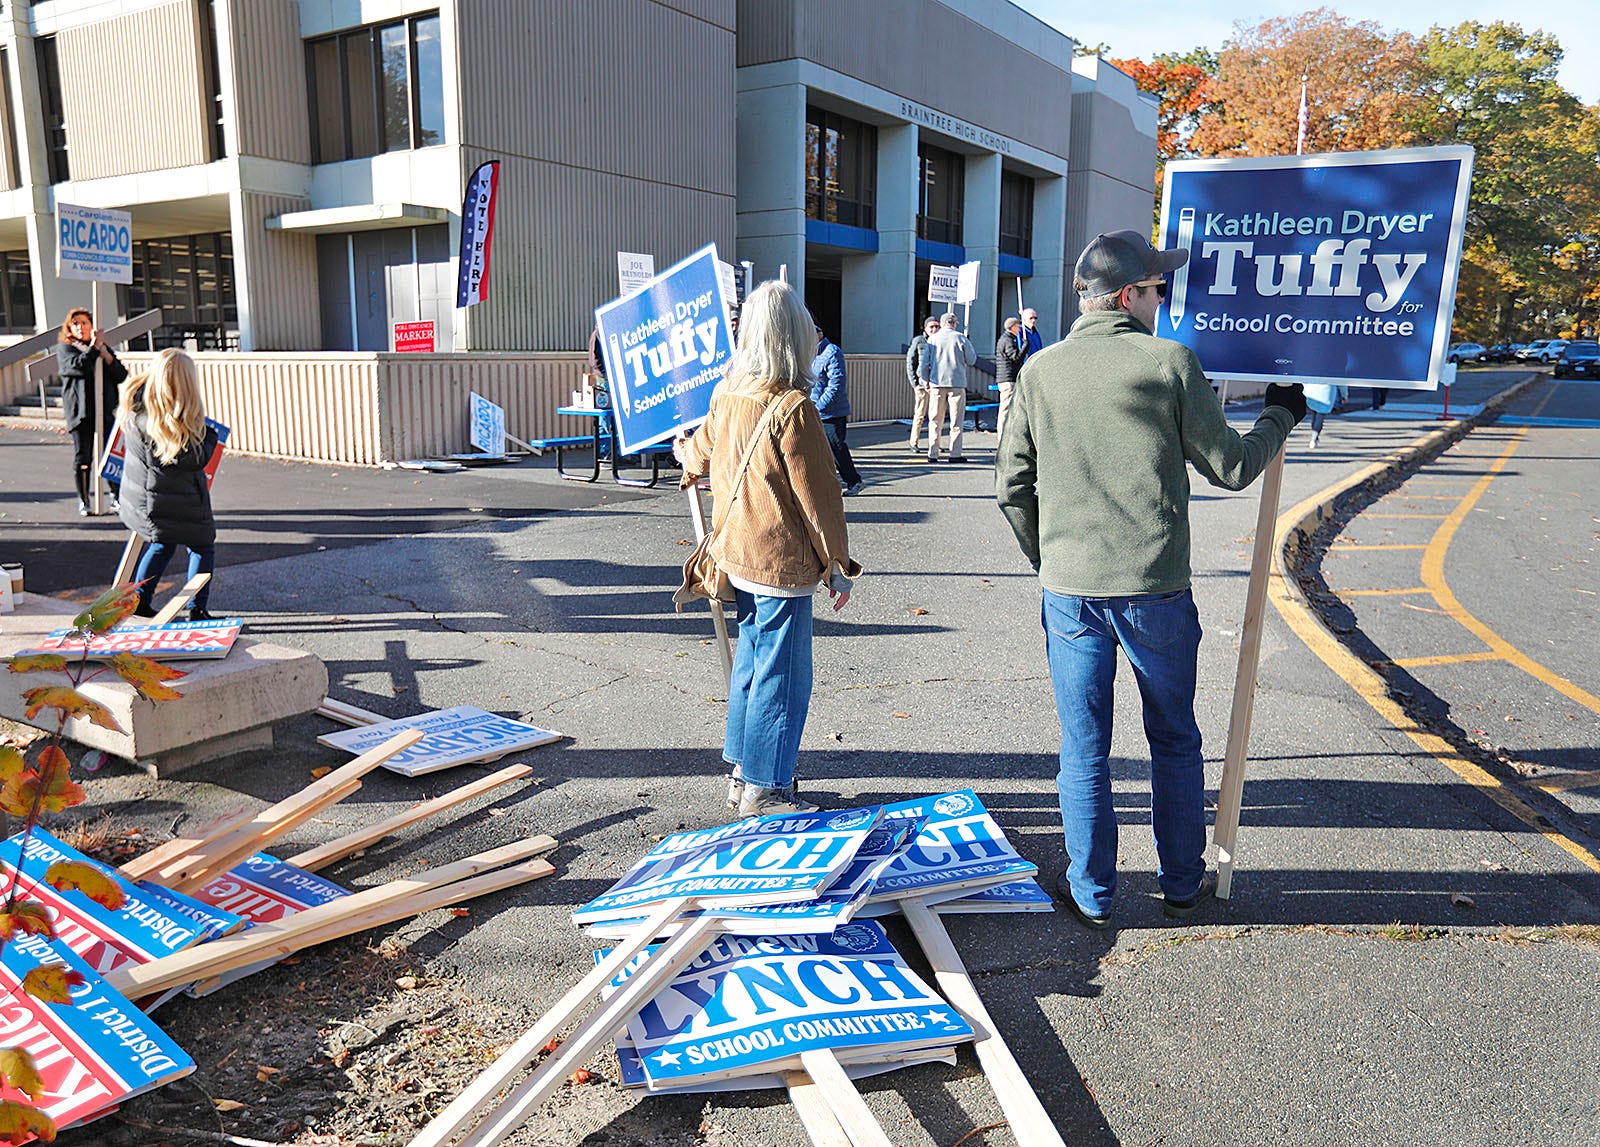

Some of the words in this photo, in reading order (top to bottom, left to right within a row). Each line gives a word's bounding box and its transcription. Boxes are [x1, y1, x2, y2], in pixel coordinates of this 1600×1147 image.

[901, 103, 951, 131] BRAINTREE
[955, 121, 976, 140] HIGH
[980, 132, 1011, 153] SCHOOL
[61, 218, 129, 253] RICARDO
[1204, 211, 1333, 236] Kathleen
[1341, 210, 1433, 240] Dryer
[630, 261, 643, 270] JOE
[1201, 239, 1428, 313] Tuffy
[621, 311, 676, 349] Kathleen
[674, 290, 713, 321] Dryer
[1193, 312, 1270, 333] School
[1274, 313, 1415, 337] Committee
[1396, 300, 1424, 316] for
[395, 330, 434, 342] MARKER
[624, 316, 719, 388] Tuffy
[715, 350, 726, 363] for
[634, 388, 667, 414] School
[665, 363, 728, 399] Committee
[478, 399, 491, 452] RICARDO
[358, 730, 386, 739] You
[443, 739, 517, 758] Carolann
[659, 816, 821, 854] Matthew
[609, 835, 856, 893] LYNCH
[886, 863, 999, 887] COMMITTEE
[611, 886, 676, 907] SCHOOL
[676, 876, 792, 893] COMMITTEE
[123, 895, 194, 950] Distric
[686, 935, 819, 972] tthew
[75, 996, 110, 1013] 1
[638, 959, 938, 1040] LYNCH
[91, 1007, 178, 1077] District
[685, 1029, 785, 1065] SCHOOL
[784, 1011, 927, 1047] COMMITTEE
